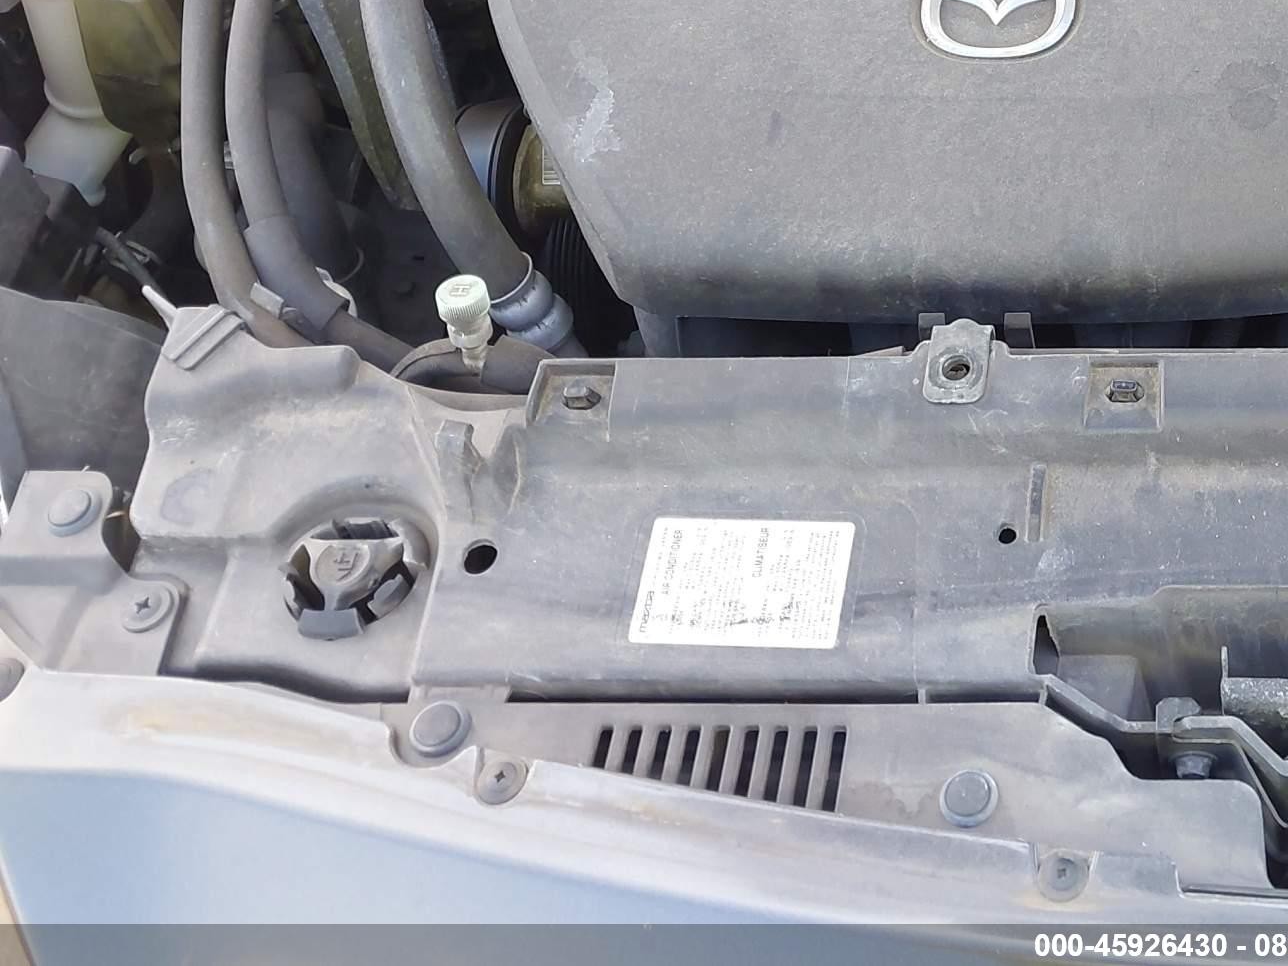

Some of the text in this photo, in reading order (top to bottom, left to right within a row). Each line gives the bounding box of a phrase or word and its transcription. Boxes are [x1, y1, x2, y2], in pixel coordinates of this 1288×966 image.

[665, 529, 683, 580] CONDITIONER
[752, 527, 769, 579] CLIMATISEUR
[639, 590, 655, 634] mazda
